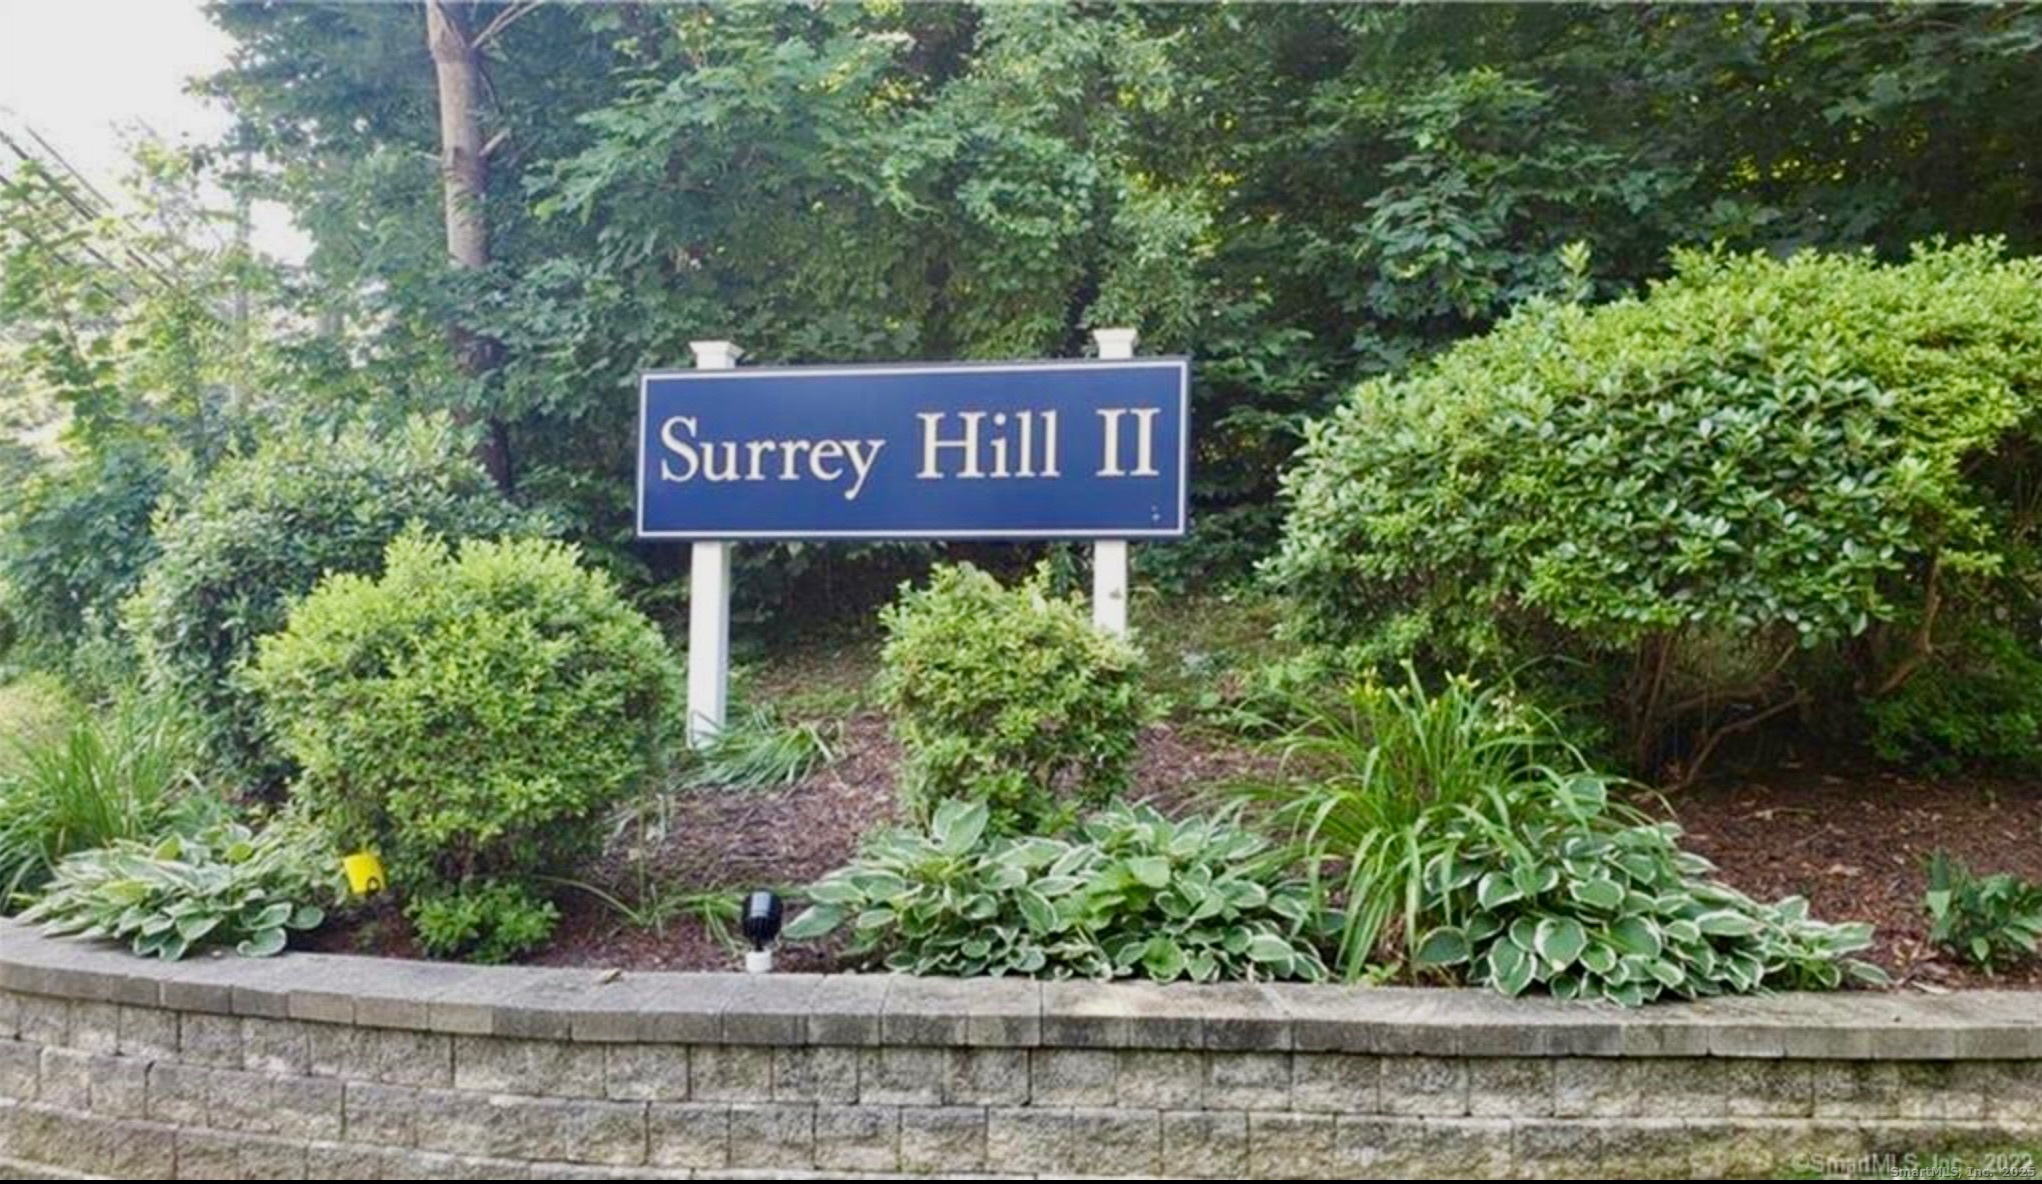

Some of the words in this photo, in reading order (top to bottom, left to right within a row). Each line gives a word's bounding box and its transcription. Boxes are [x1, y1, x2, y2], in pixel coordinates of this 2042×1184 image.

[661, 416, 885, 500] Surrey
[916, 410, 1061, 479] Hill
[1096, 407, 1161, 478] II
